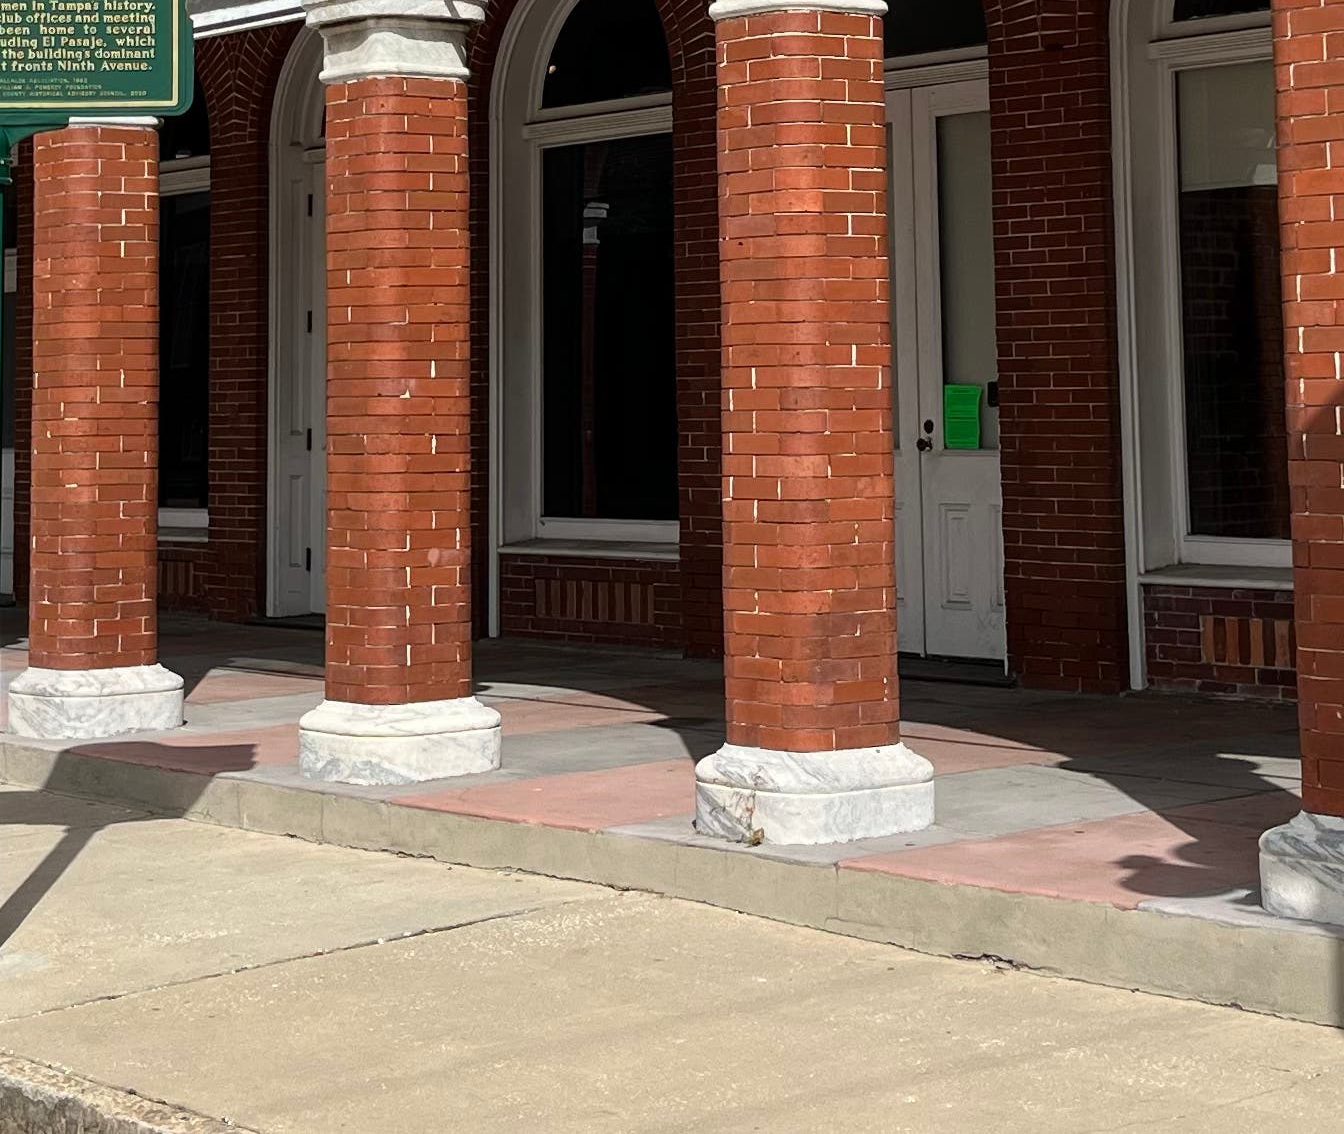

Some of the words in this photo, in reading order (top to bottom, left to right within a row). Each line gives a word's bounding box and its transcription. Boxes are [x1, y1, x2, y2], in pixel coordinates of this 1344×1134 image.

[31, 1, 45, 11] in
[49, 1, 99, 13] Tampa's
[103, 0, 156, 12] history.
[25, 14, 72, 24] offices
[74, 13, 100, 23] and
[103, 13, 156, 25] meeting
[39, 26, 75, 36] home
[84, 25, 97, 35] to
[105, 25, 156, 35] several
[42, 38, 55, 48] El
[60, 37, 107, 49] Pasaje,
[116, 37, 156, 47] which
[27, 50, 91, 62] building's
[94, 49, 155, 59] dominant
[10, 62, 53, 72] fronts
[57, 62, 95, 72] Ninth
[99, 61, 153, 71] Avenue.
